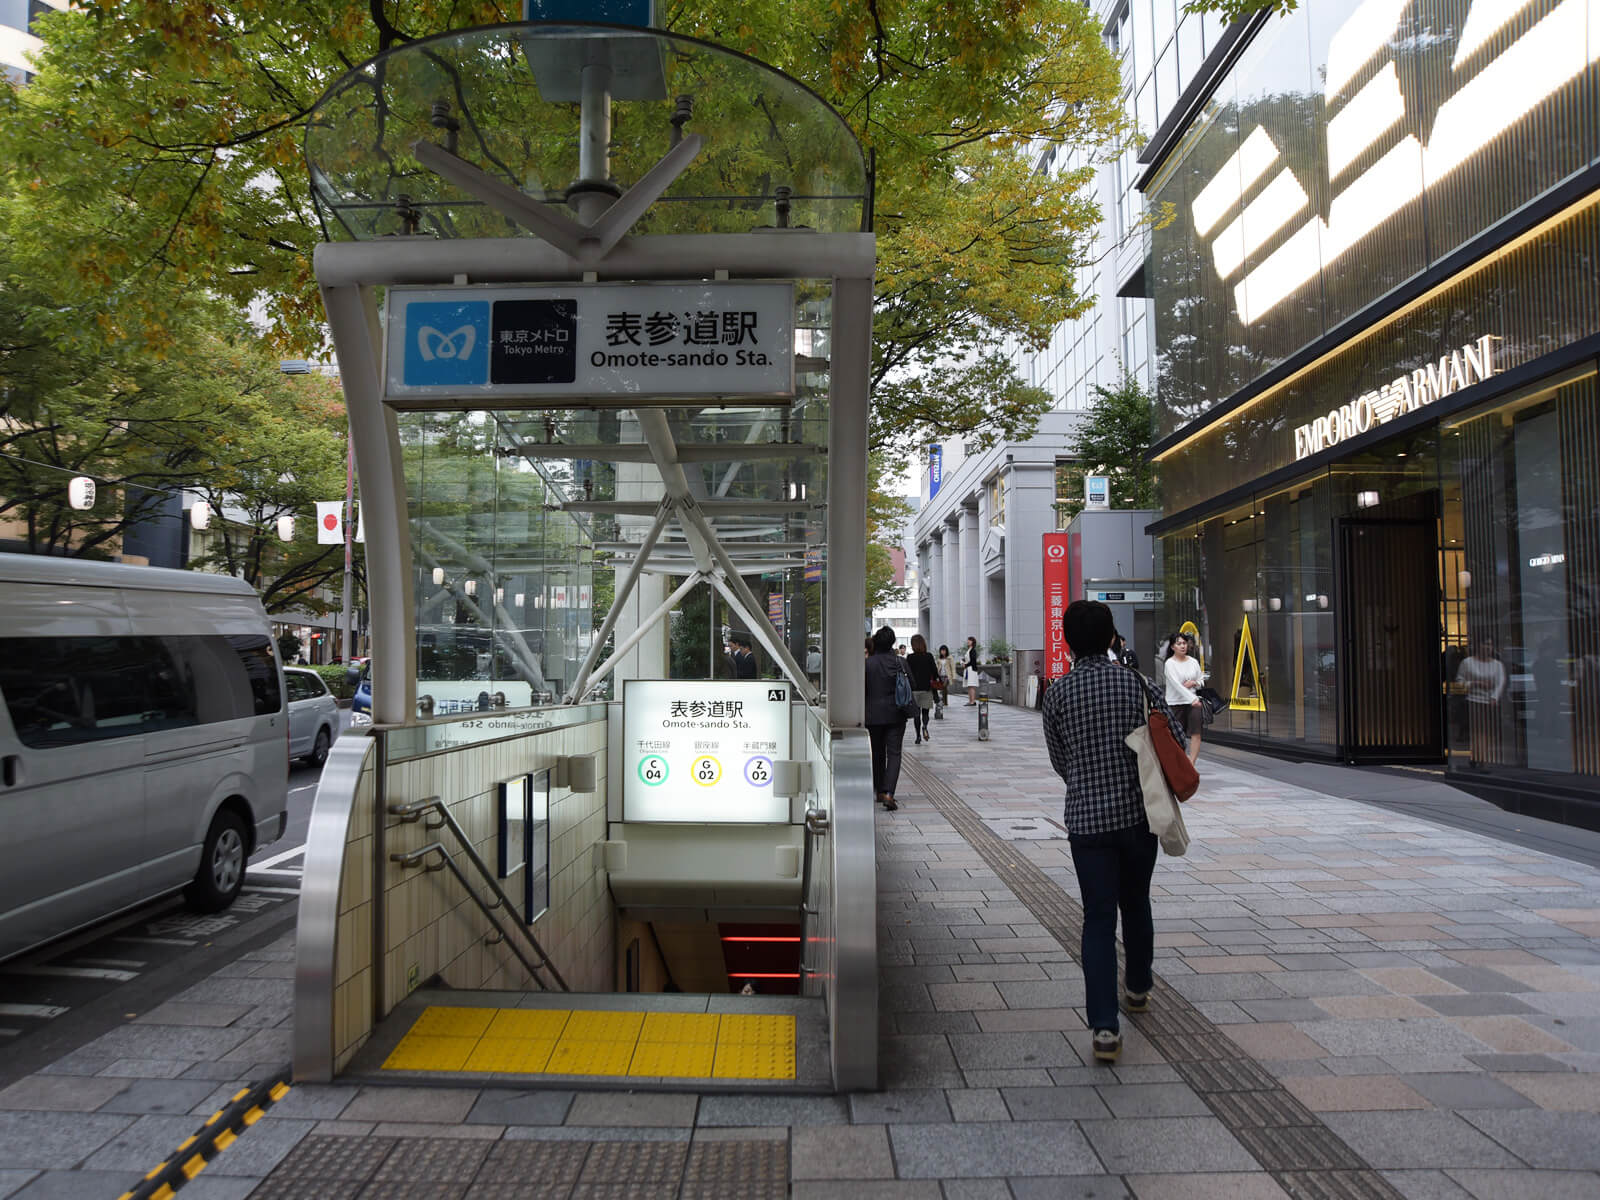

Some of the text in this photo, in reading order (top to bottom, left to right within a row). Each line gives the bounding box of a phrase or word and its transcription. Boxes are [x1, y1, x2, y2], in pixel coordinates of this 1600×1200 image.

[605, 311, 760, 347] 表参道駅
[499, 329, 569, 343] 東京メトロ
[503, 344, 564, 356] Tokyo Metro
[590, 350, 773, 367] Omote-sando Sta.
[1294, 334, 1497, 461] EMPORIO ARMANI
[768, 691, 785, 701] A1
[670, 700, 743, 718] 表参道駅
[662, 719, 751, 729] Omote-sando Sta.
[650, 759, 657, 769] C
[702, 760, 711, 769] G
[757, 761, 763, 770] Z
[646, 770, 661, 779] 04
[699, 771, 714, 780] 02
[752, 771, 767, 780] 02
